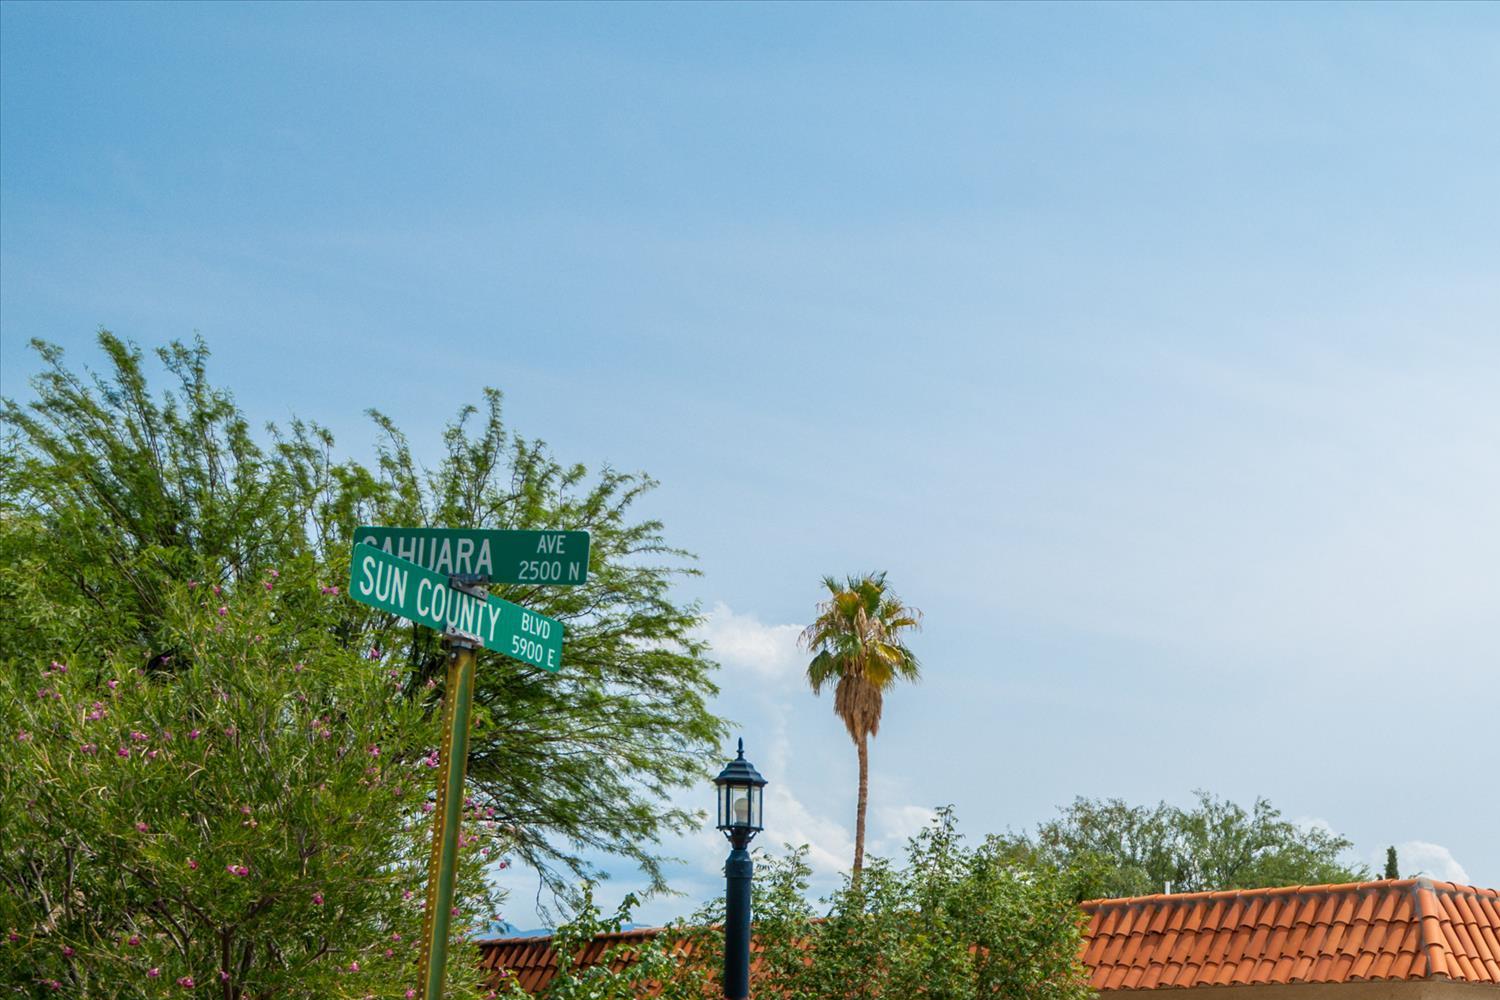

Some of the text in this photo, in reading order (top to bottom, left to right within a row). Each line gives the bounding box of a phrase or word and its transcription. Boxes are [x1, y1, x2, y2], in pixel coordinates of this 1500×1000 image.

[363, 535, 566, 575] HUARA AVE
[518, 560, 580, 581] 2500 N
[360, 556, 550, 641] SUN COUNTY BLVD
[511, 635, 556, 668] 5900 E
